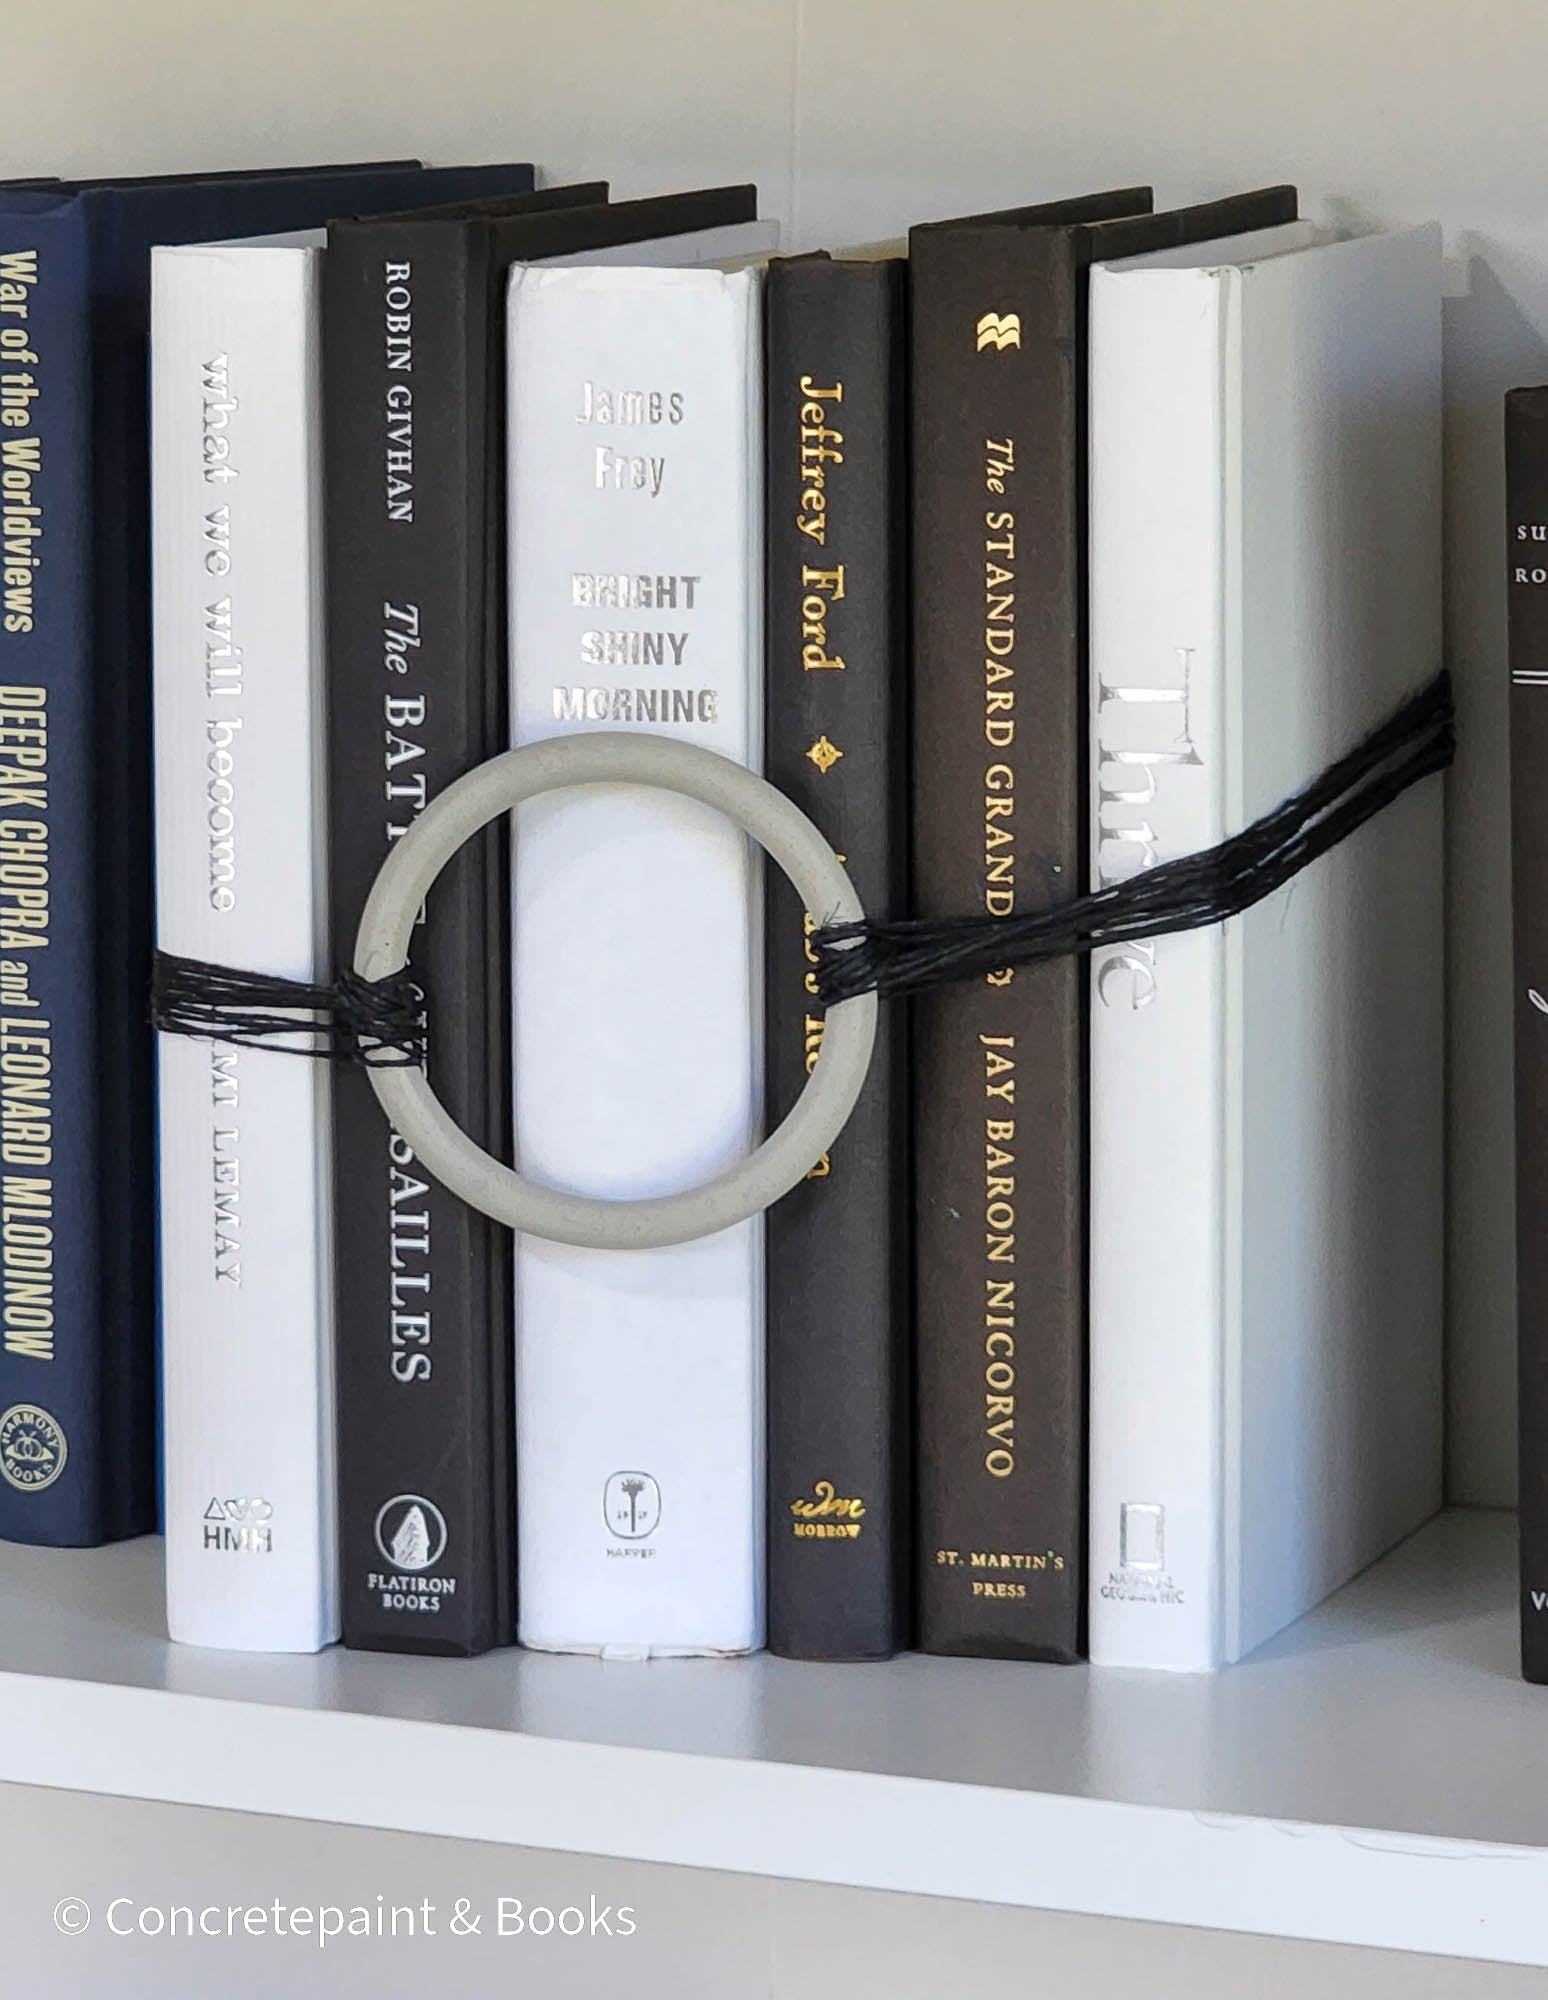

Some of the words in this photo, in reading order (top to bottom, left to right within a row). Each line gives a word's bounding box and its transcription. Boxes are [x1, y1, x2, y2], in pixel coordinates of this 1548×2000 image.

[0, 250, 37, 318] War
[385, 261, 413, 372] ROBIN
[0, 328, 38, 365] of
[0, 372, 40, 428] the
[200, 352, 240, 485] what
[575, 381, 685, 426] James
[386, 384, 413, 523] GIVHAN
[595, 447, 666, 497] Frey
[796, 374, 843, 545] Jeffrey
[984, 437, 1014, 495] The
[2, 437, 42, 633] Worldviews
[204, 503, 233, 577] we
[571, 573, 701, 609] BRIGHT
[801, 563, 846, 671] Ford
[205, 595, 242, 699] will
[383, 602, 420, 675] The
[581, 630, 690, 666] SHINY
[984, 511, 1015, 747] STANDARD
[552, 687, 719, 722] MORNING
[0, 685, 47, 809] DEEPAK
[206, 717, 243, 913] become
[984, 764, 1015, 917] GRAND
[0, 819, 49, 950] CHOPRA
[0, 960, 40, 1008] and
[1, 1017, 52, 1166] LEONARD
[979, 1034, 1015, 1106] JAY
[210, 1127, 241, 1288] LEMAY
[984, 1118, 1015, 1264] BARON
[2, 1175, 54, 1361] MLODINOW
[984, 1279, 1015, 1478] NICORVO
[3, 1412, 60, 1448] HARMONY
[6, 1459, 53, 1482] BOOKS
[204, 1525, 273, 1552] HMH
[794, 1523, 861, 1538] MORROW
[937, 1550, 964, 1566] ST.
[971, 1551, 1064, 1569] MARTIN'S
[368, 1573, 456, 1594] FLATIRON
[383, 1593, 440, 1611] BOOKS
[972, 1582, 1026, 1598] PRESS
